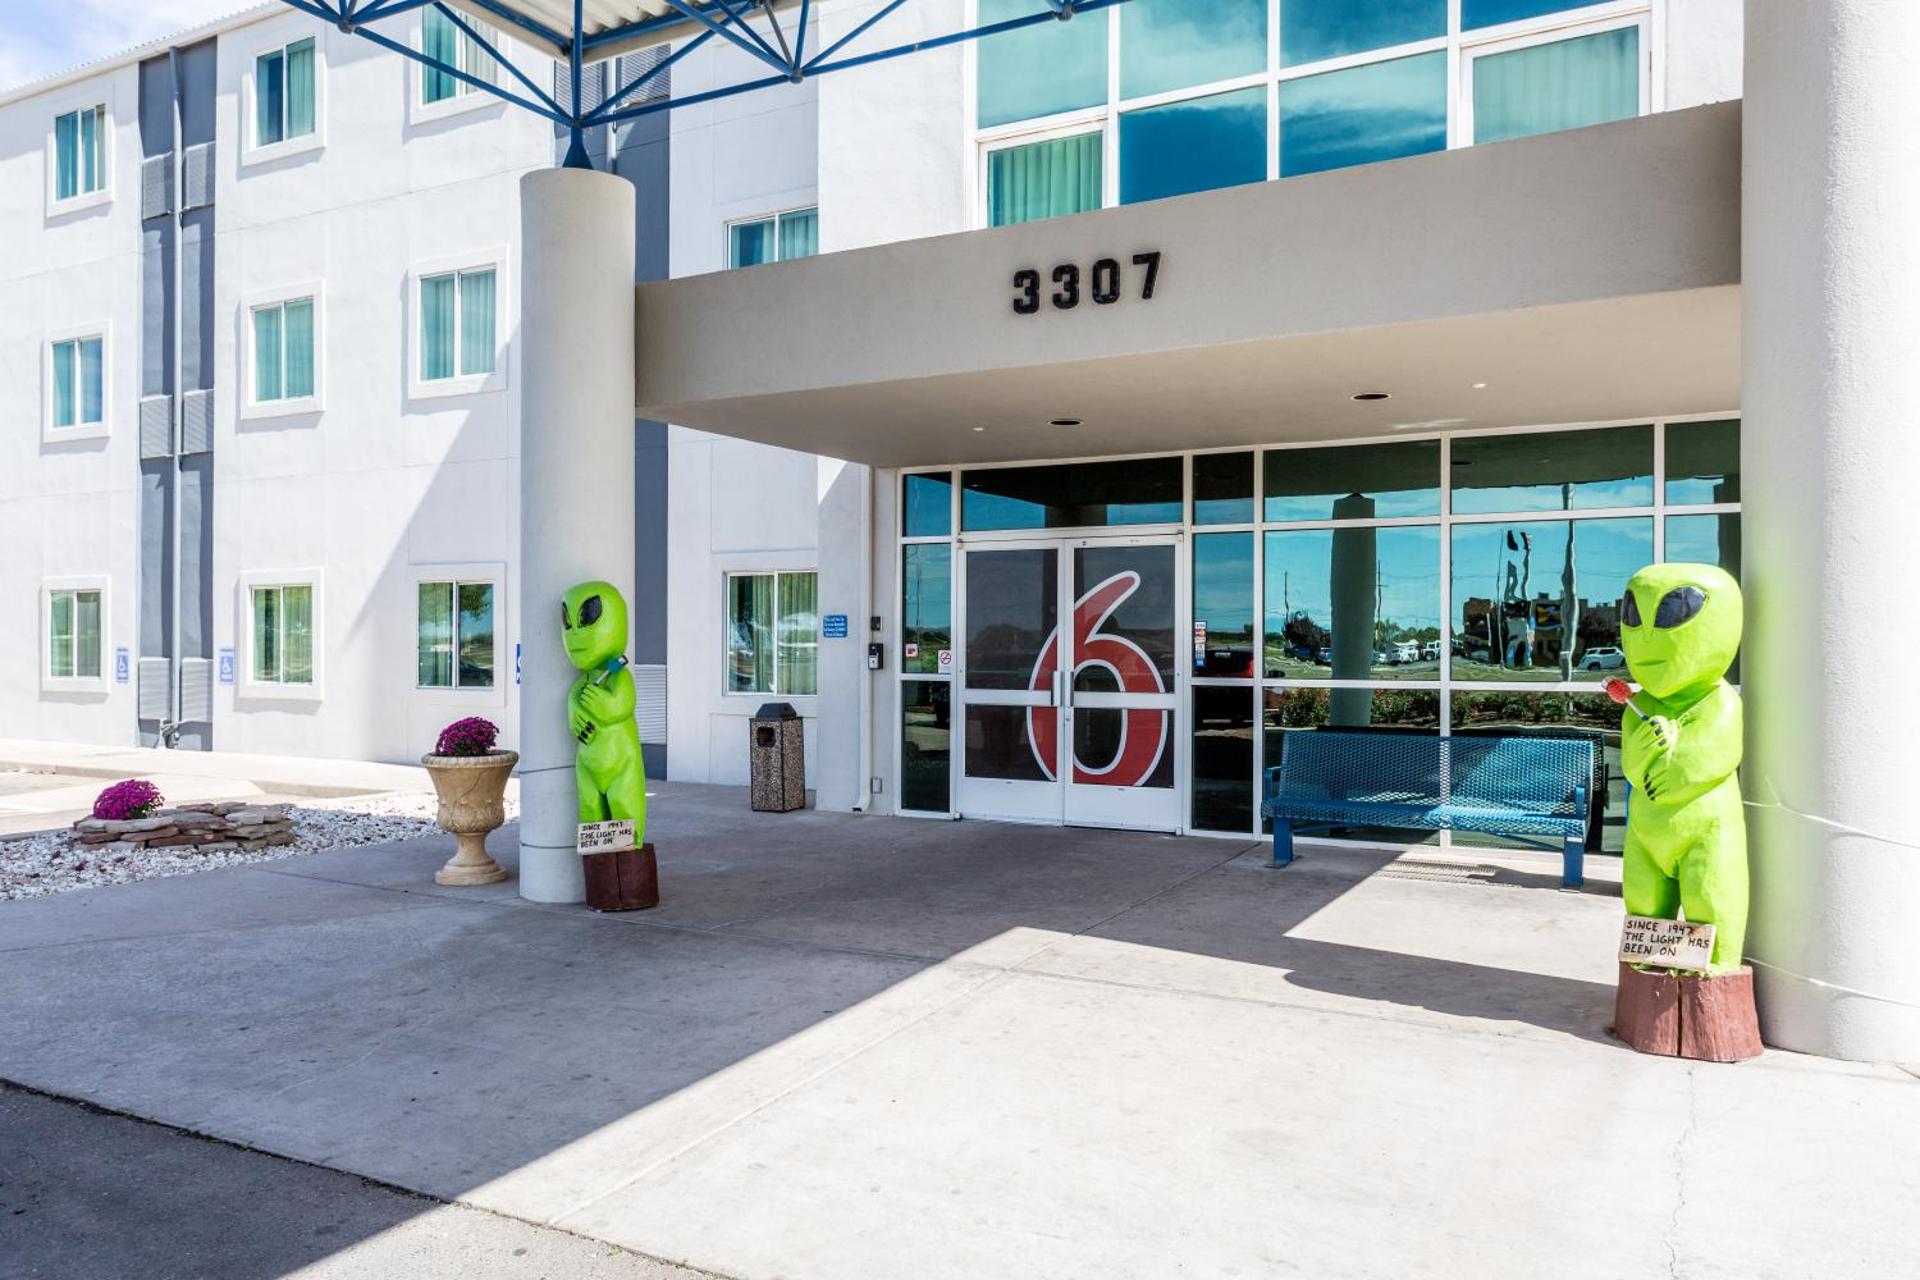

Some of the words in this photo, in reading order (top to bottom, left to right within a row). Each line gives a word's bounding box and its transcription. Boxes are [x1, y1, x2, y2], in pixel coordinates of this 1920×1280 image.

[1013, 251, 1161, 314] 3307
[1026, 570, 1168, 787] 6
[581, 832, 594, 840] THE
[596, 830, 616, 838] LIGHT
[581, 840, 598, 848] BEEN
[1626, 920, 1660, 932] SINCE
[1668, 925, 1694, 936] 1947
[1624, 931, 1645, 942] THE
[1650, 934, 1683, 945] LIGHT
[1687, 938, 1710, 949] HAS
[1623, 943, 1652, 954] BEEN
[1659, 947, 1677, 957] ON
